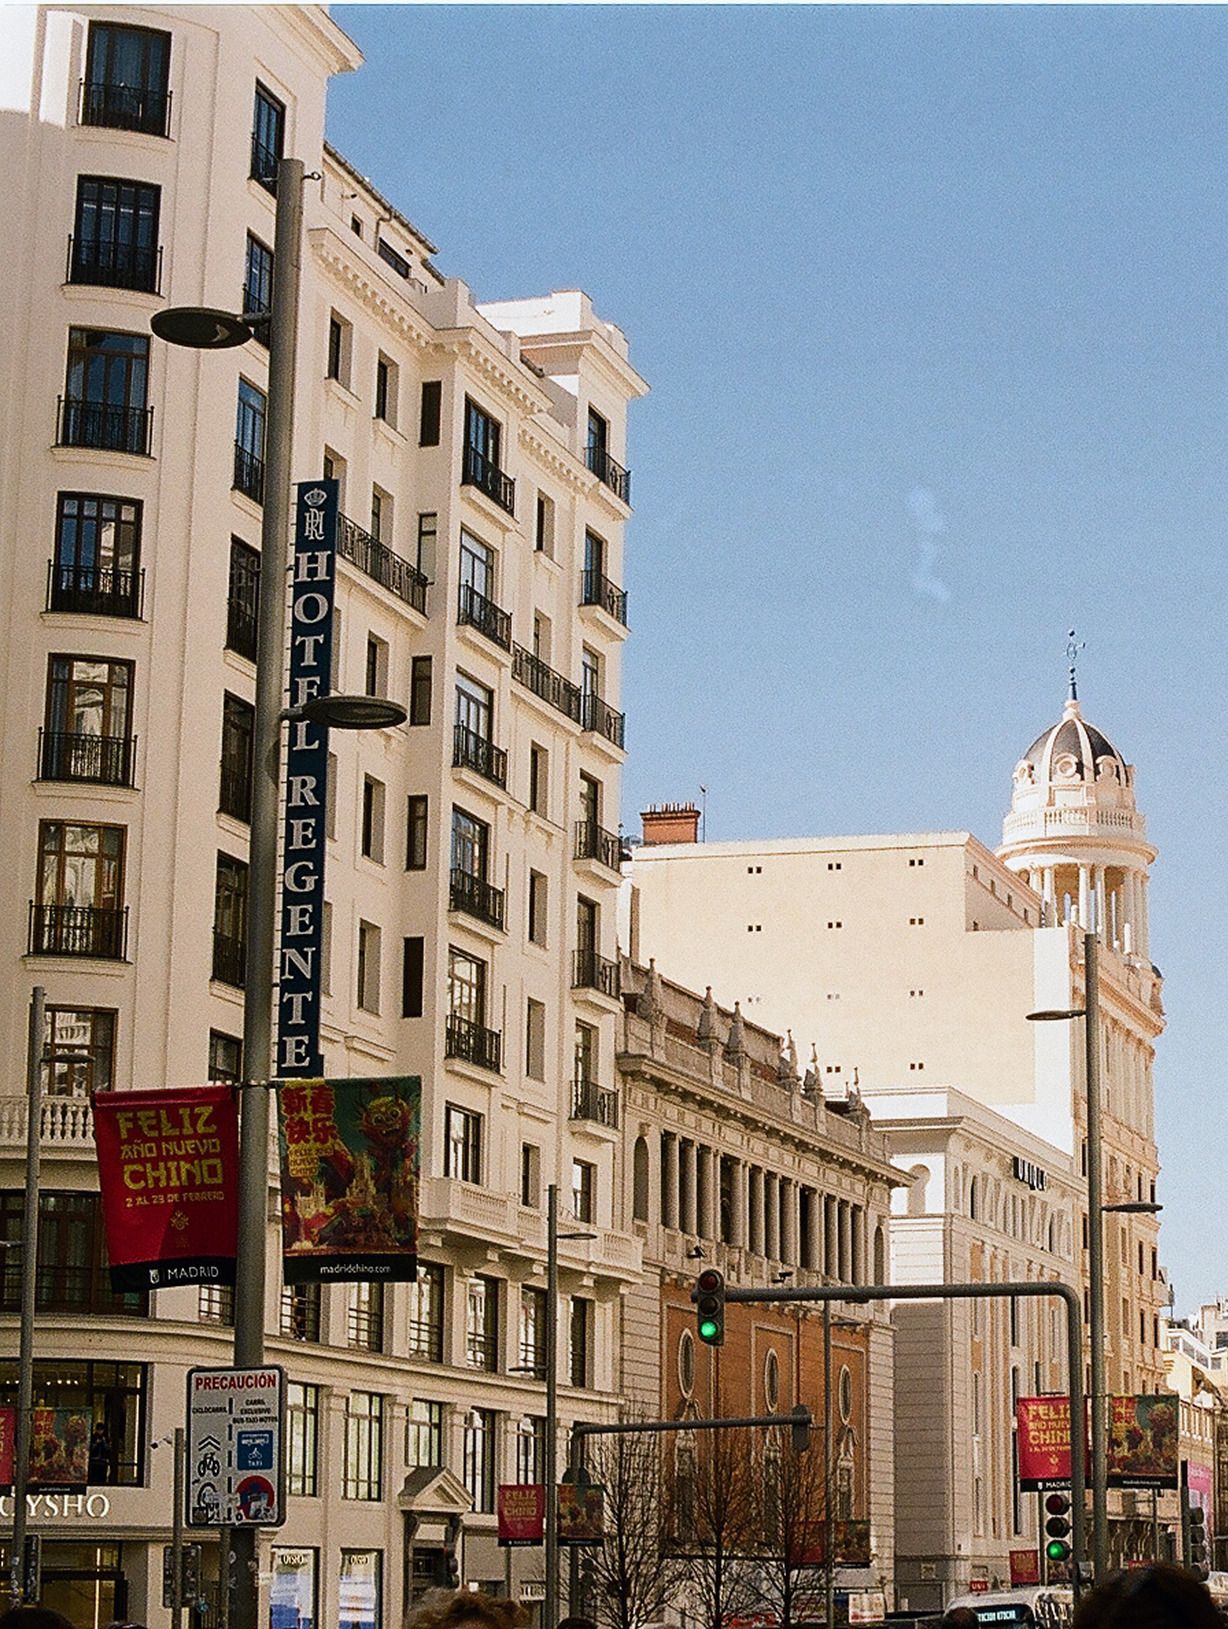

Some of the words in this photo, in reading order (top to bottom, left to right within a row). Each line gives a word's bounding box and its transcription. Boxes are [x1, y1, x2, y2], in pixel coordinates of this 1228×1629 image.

[293, 550, 331, 750] HOTEL
[281, 775, 320, 1068] REGENTE
[116, 1106, 218, 1139] FELIZ
[120, 1140, 157, 1160] AÑO
[162, 1138, 220, 1156] NUEVO
[124, 1158, 224, 1190] CHINO
[126, 1198, 133, 1208] 2
[152, 1194, 165, 1204] 23
[167, 1194, 180, 1203] DE
[167, 1266, 219, 1280] MADRID
[195, 1373, 276, 1390] PRECAUCIÓN
[1029, 1429, 1071, 1445] CHIN
